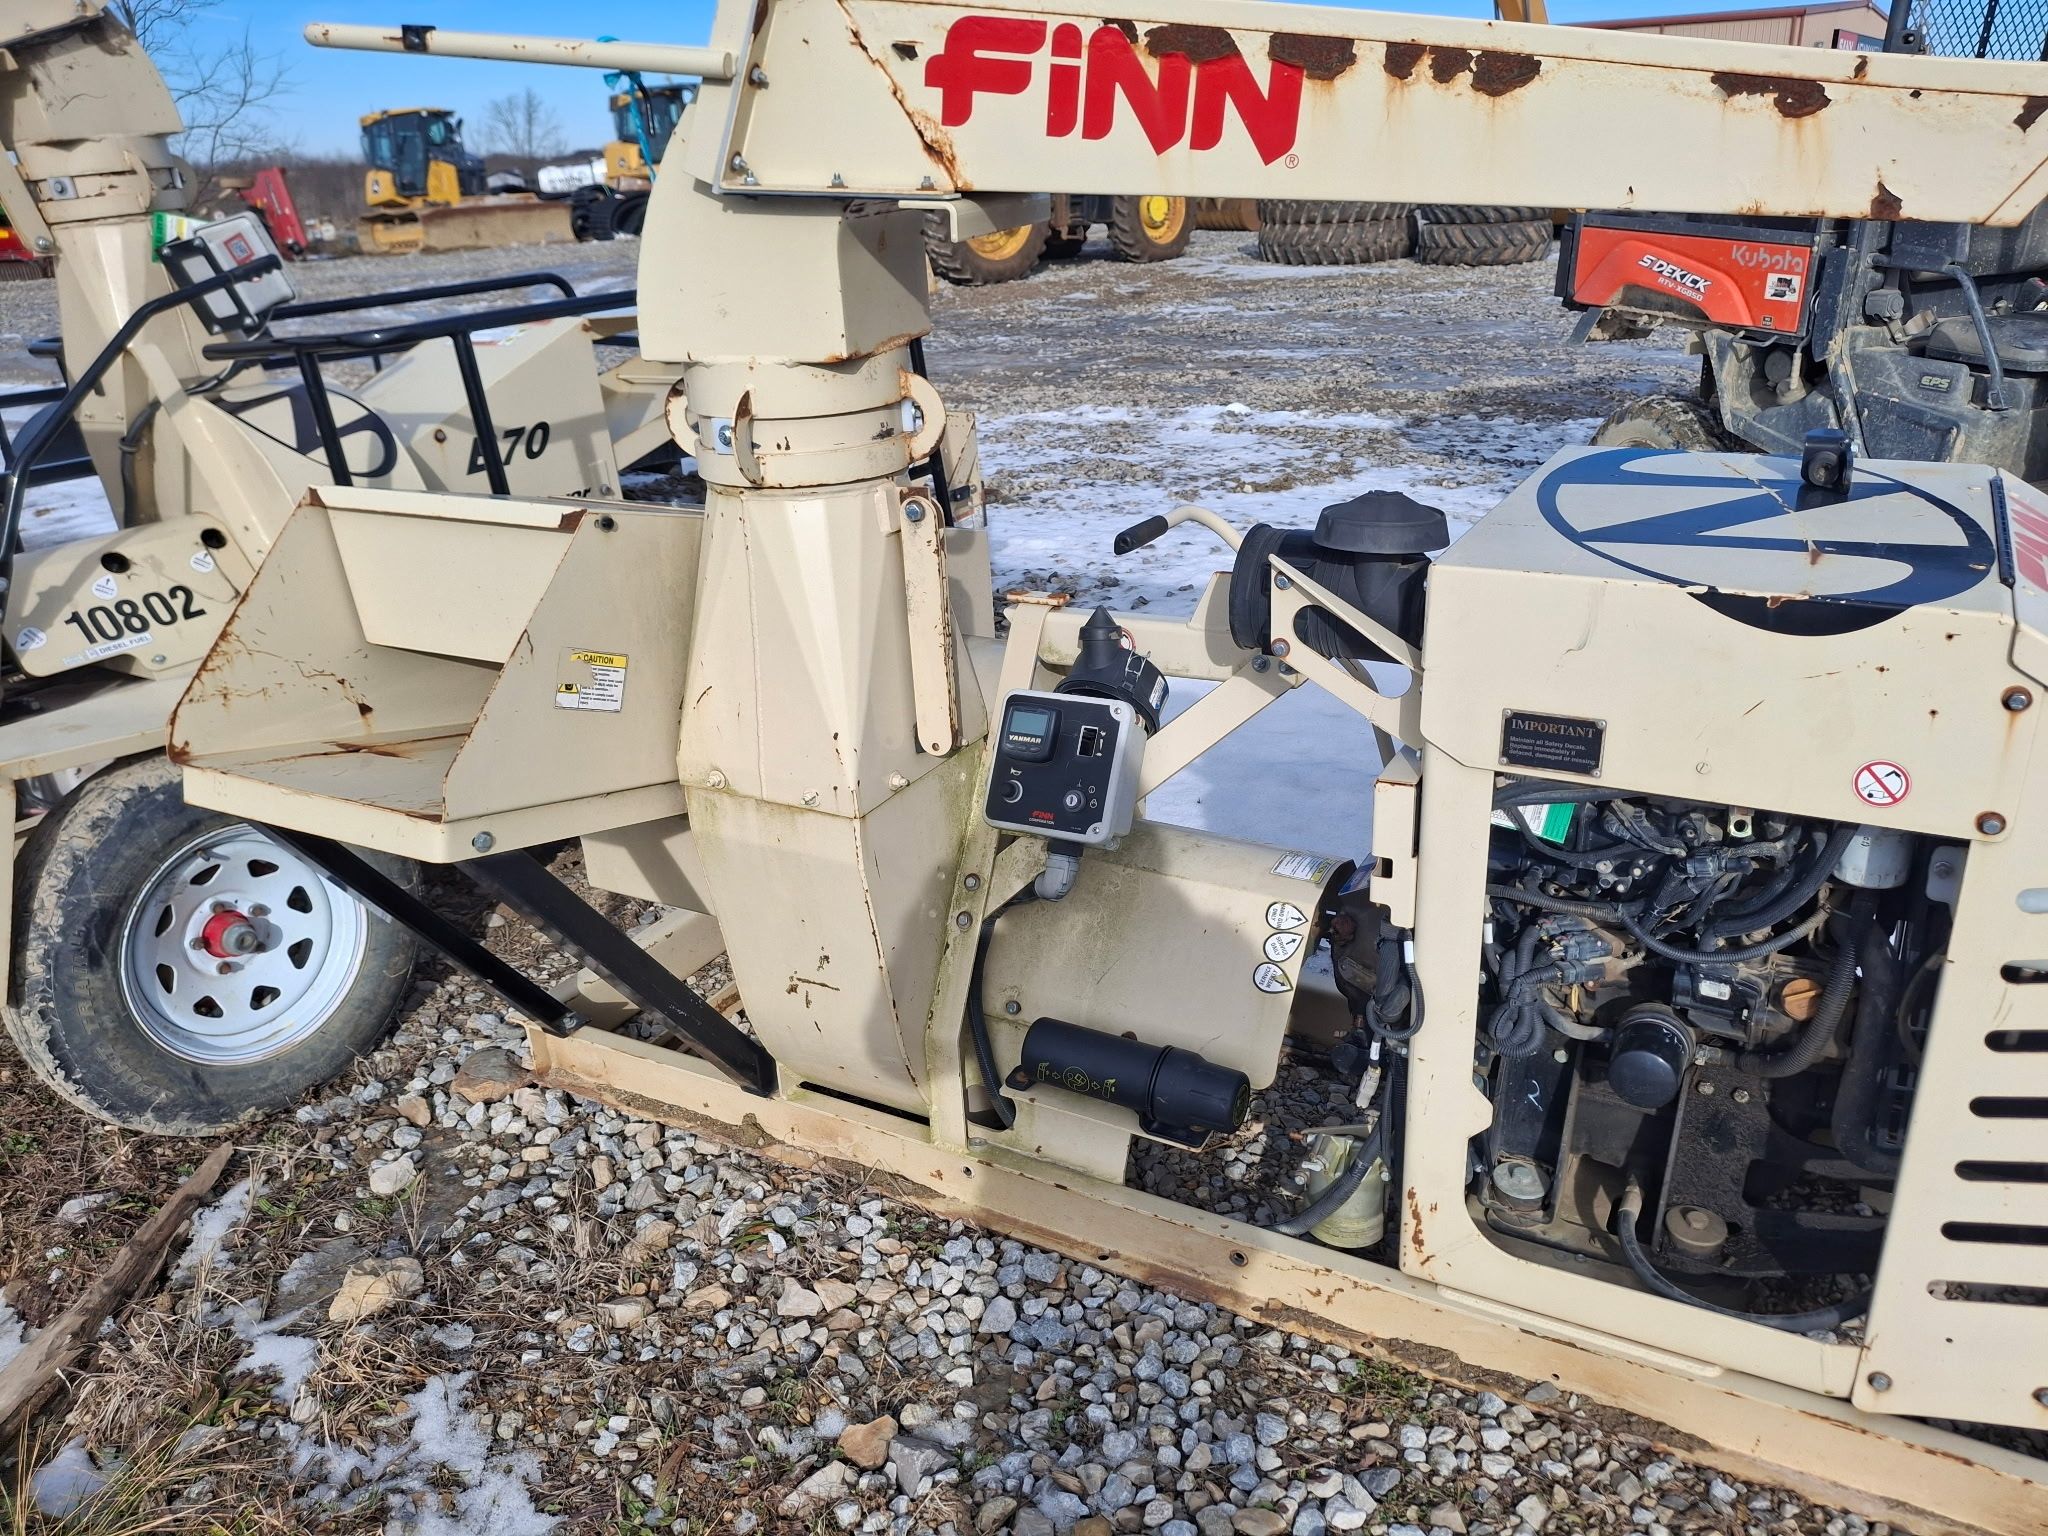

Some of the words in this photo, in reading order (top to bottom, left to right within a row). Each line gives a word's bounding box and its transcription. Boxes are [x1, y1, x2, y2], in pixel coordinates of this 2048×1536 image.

[1731, 245, 1803, 272] Kubota
[1921, 375, 1951, 389] EPS
[64, 585, 207, 645] 10802
[583, 654, 614, 665] CAUTION
[1511, 719, 1596, 738] IMPORTANT
[1008, 734, 1042, 744] YANMAR
[1028, 817, 1055, 826] CORPORATION
[1270, 942, 1281, 957] DAILY
[1276, 936, 1289, 956] SERVICE
[1258, 966, 1272, 986] SERVICE
[1265, 970, 1278, 989] WEEKLY
